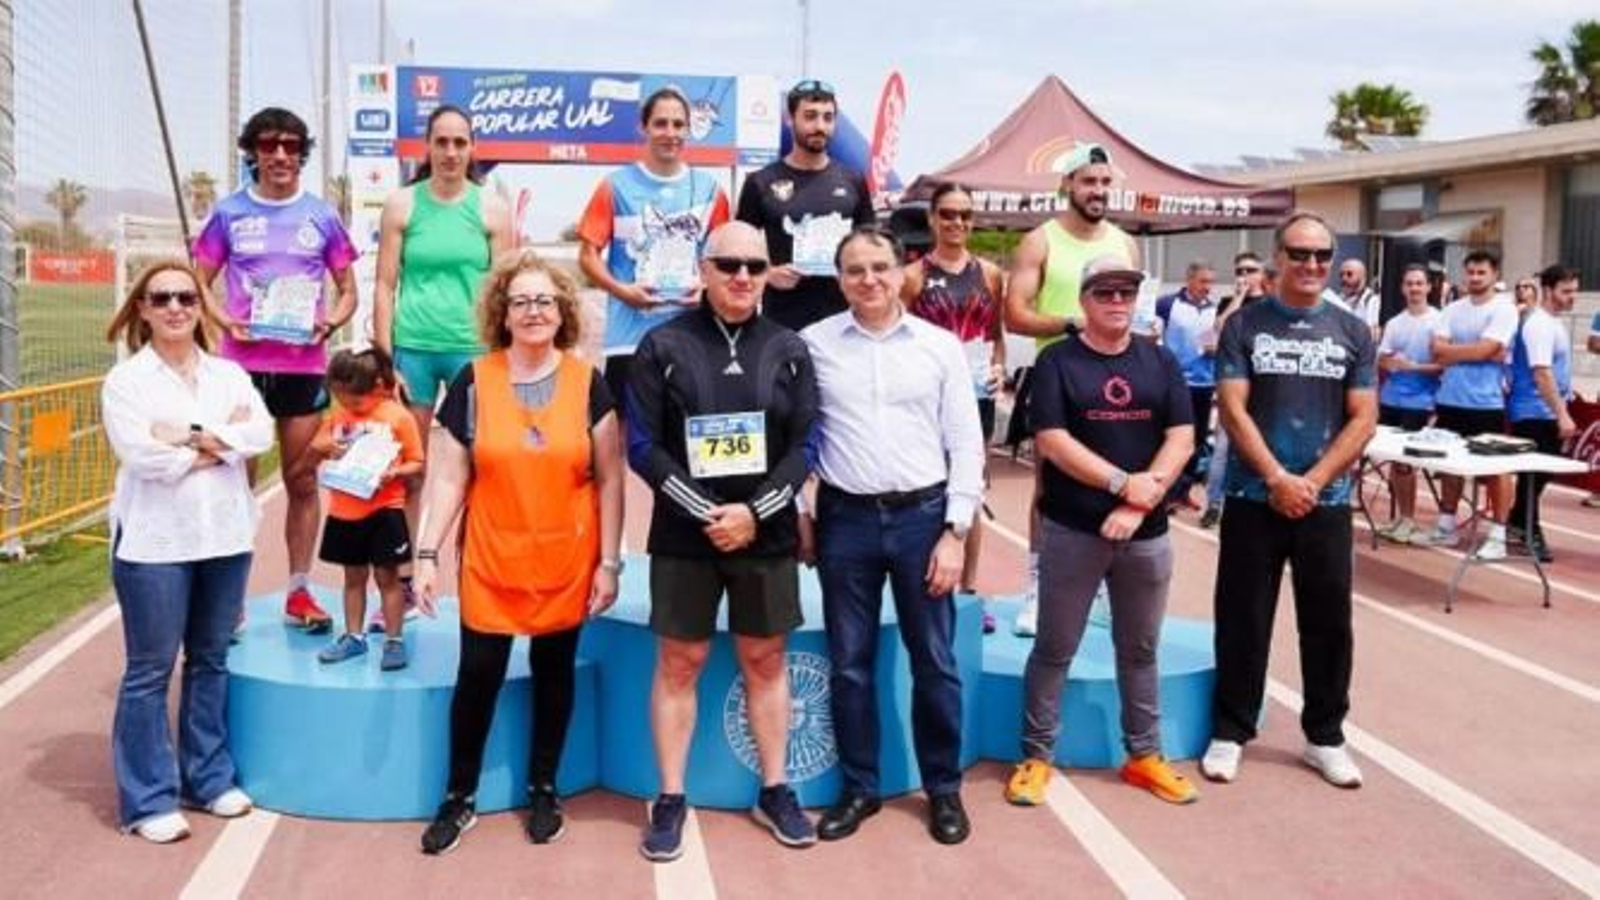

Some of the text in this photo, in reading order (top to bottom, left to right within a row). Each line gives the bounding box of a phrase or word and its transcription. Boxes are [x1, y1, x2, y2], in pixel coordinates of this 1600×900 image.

[469, 86, 564, 111] CARRERA
[471, 99, 614, 134] POPULAR UAL
[549, 144, 588, 160] META
[705, 436, 751, 457] 736
